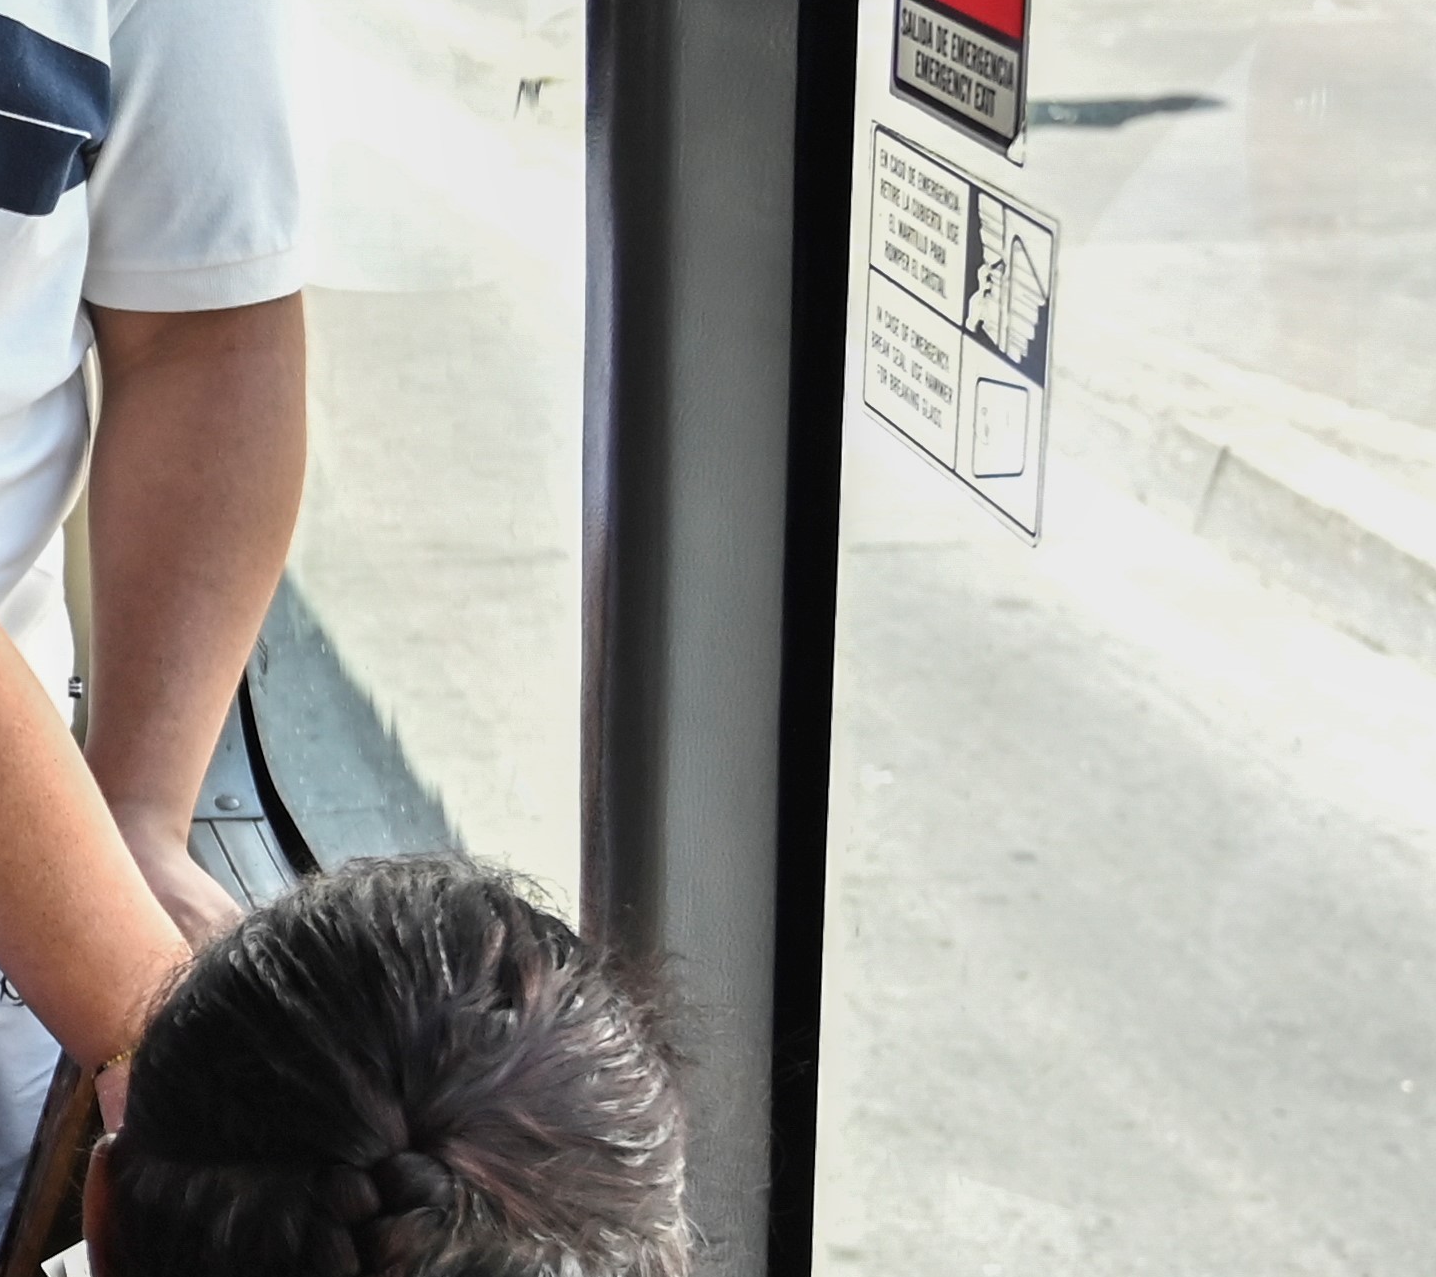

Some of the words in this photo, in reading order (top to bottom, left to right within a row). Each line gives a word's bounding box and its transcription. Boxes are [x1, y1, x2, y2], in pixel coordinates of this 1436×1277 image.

[901, 8, 932, 49] SALIDA
[936, 25, 948, 58] DE
[952, 33, 1014, 91] EMERGENCIA
[916, 50, 972, 104] EMERGENCY
[974, 82, 996, 117] EXIT
